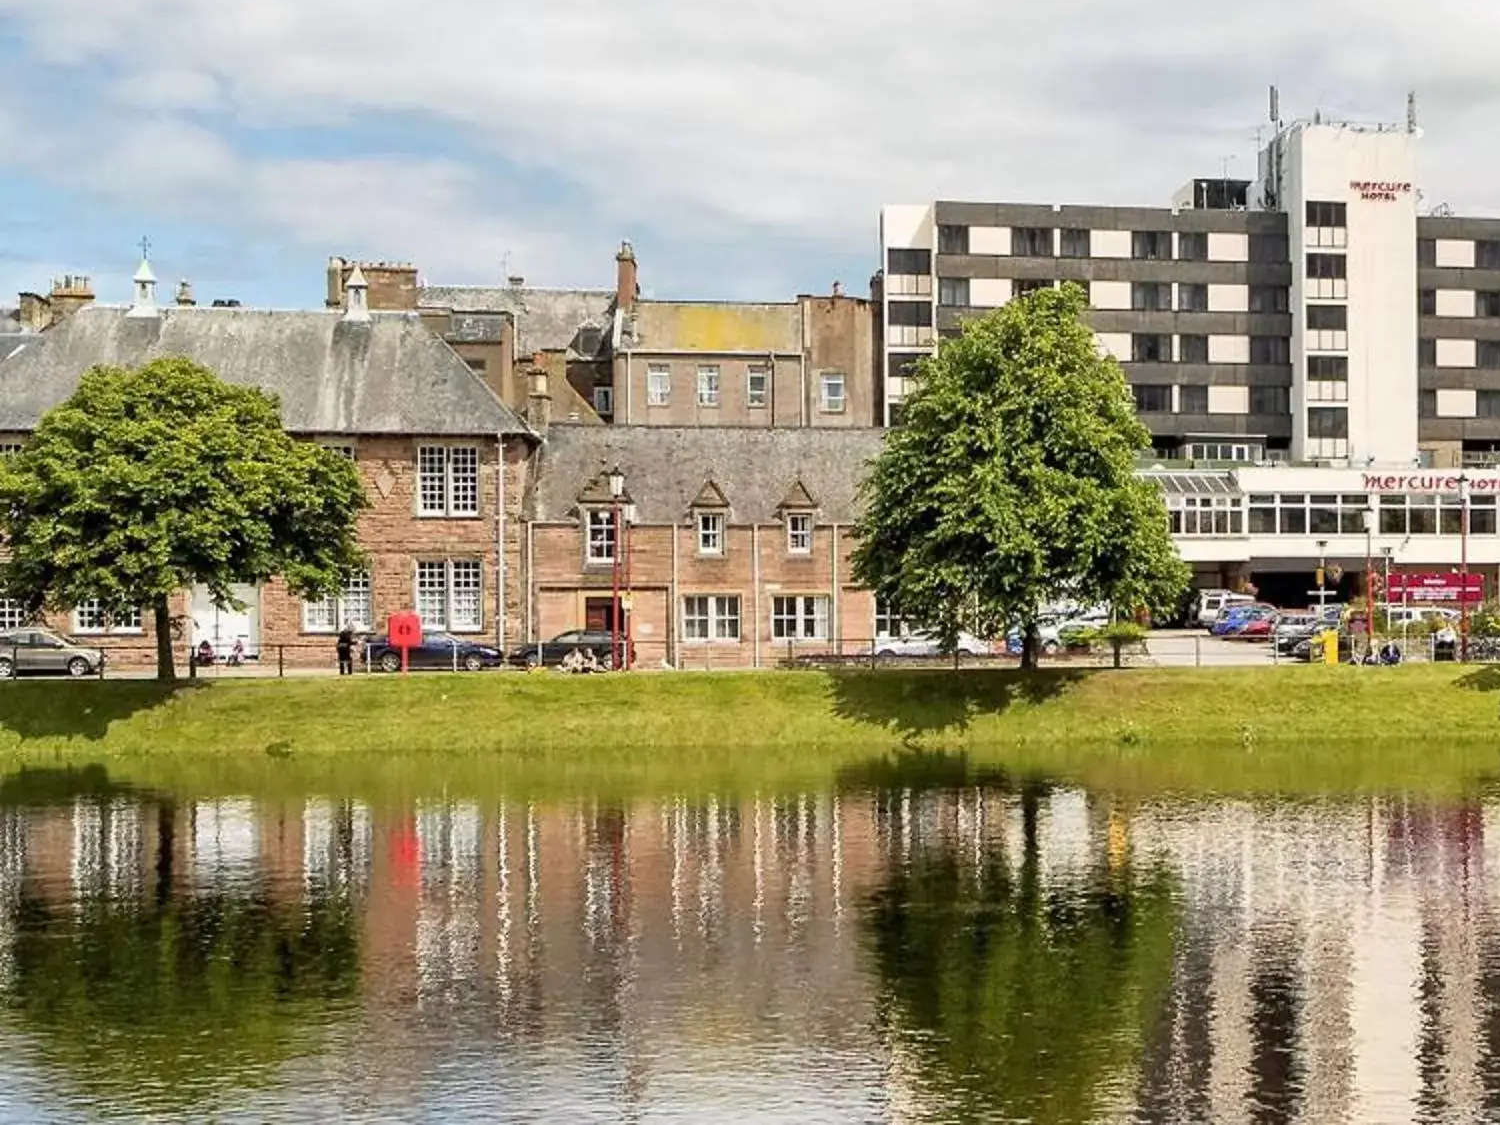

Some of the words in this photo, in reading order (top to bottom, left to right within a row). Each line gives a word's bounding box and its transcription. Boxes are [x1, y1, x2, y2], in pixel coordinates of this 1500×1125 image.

[1350, 181, 1411, 192] mercure
[1361, 192, 1397, 201] HOTEL
[1362, 473, 1458, 490] mercure
